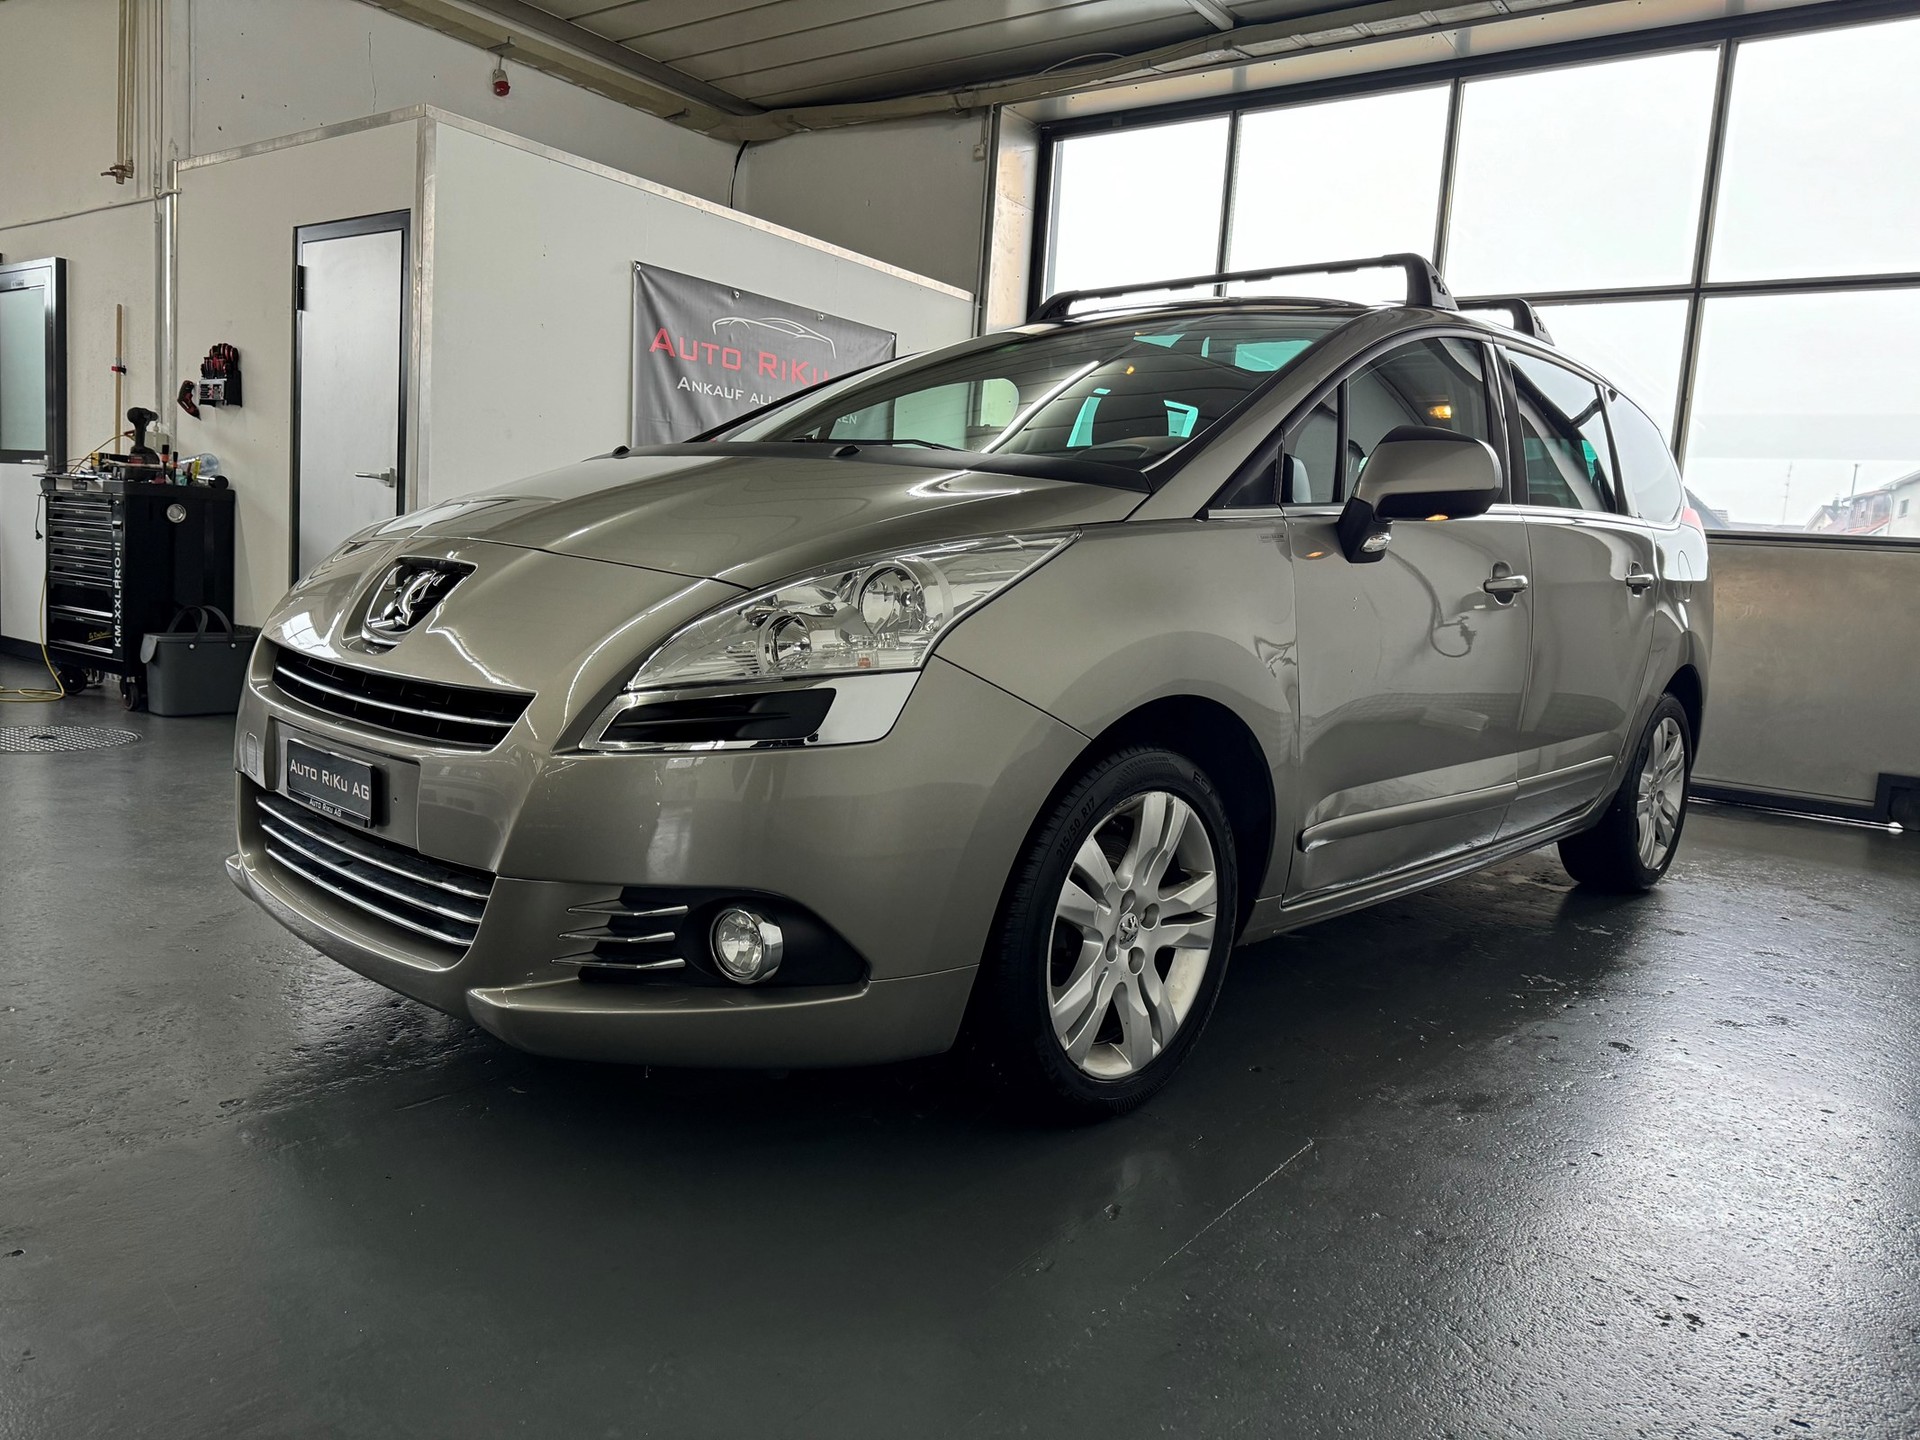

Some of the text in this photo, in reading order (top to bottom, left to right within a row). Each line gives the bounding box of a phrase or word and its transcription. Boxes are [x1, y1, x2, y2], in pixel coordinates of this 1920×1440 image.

[649, 327, 742, 371] AUTO
[677, 376, 745, 400] ANKAUF
[290, 759, 369, 800] AUTO RIKU AG
[309, 798, 321, 809] AUTO
[334, 808, 342, 817] AG
[1081, 796, 1096, 819] R17
